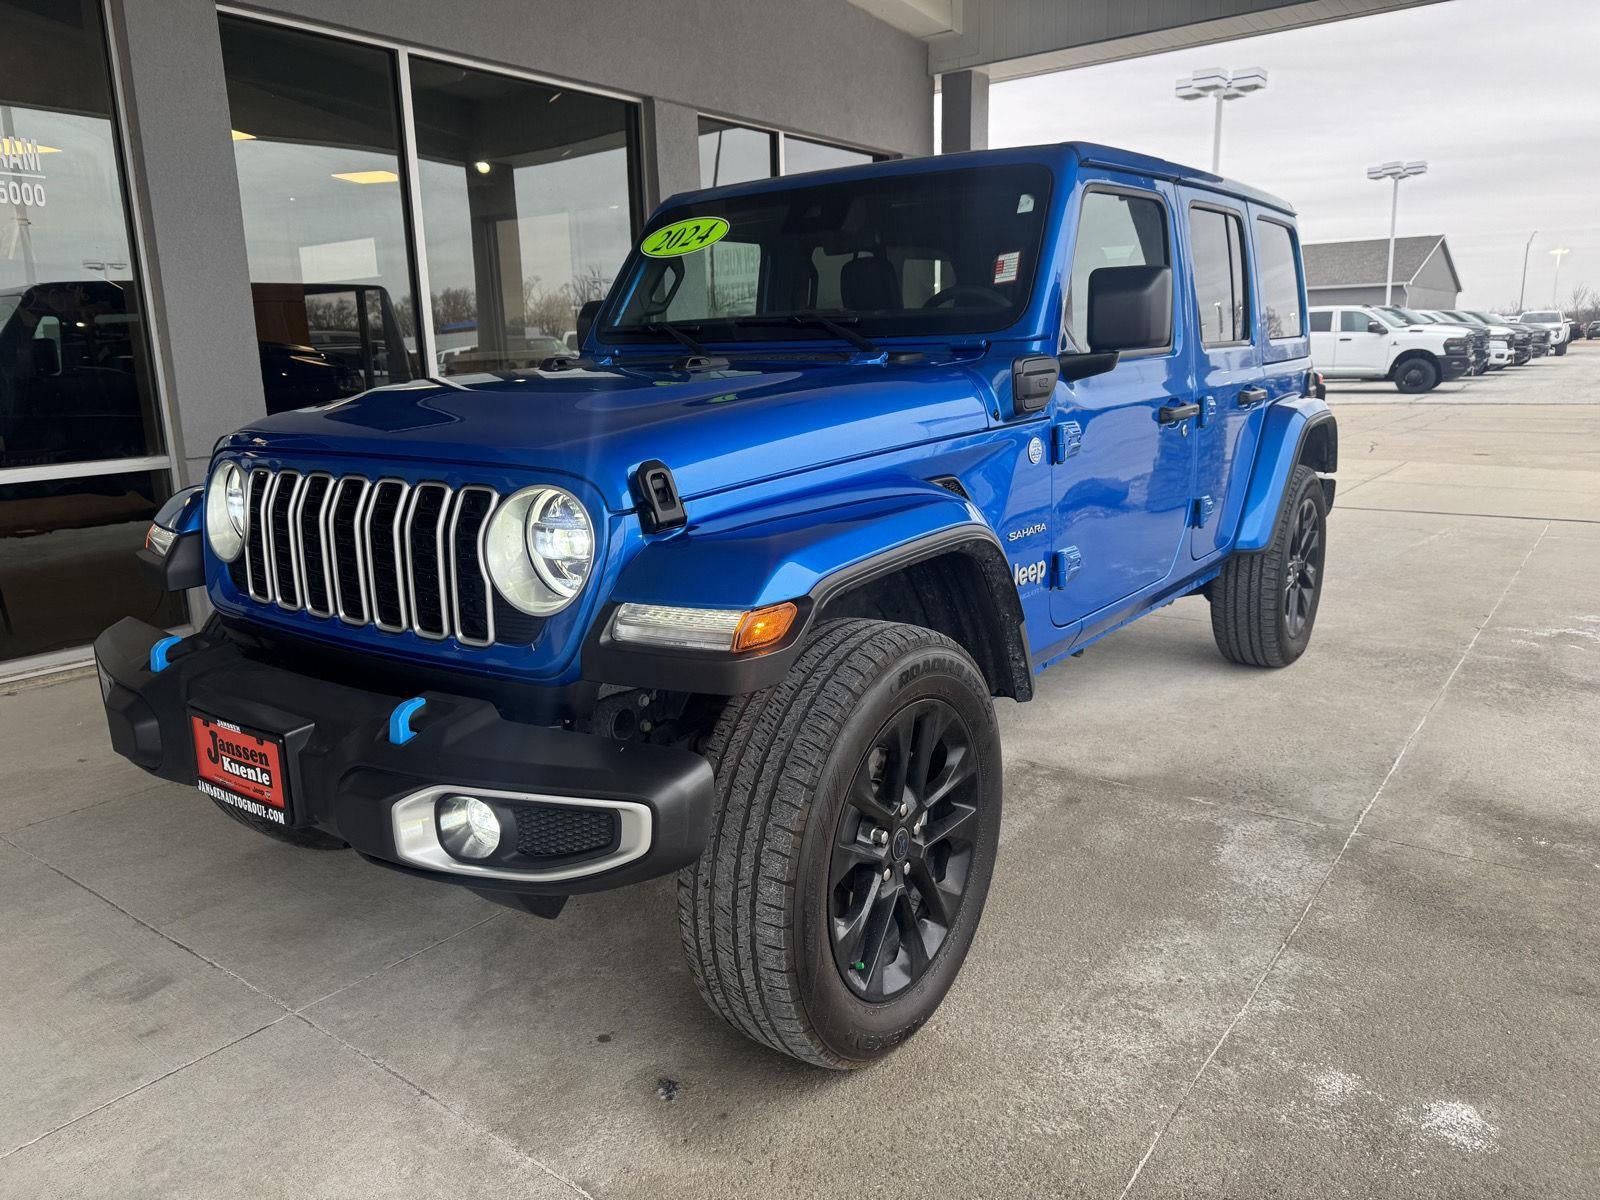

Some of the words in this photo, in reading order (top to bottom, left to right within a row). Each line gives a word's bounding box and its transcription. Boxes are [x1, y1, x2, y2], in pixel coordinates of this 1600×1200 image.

[650, 221, 719, 252] 2024
[1008, 523, 1047, 542] SAHARA
[1013, 560, 1047, 586] Jeep
[207, 730, 270, 767] Janssen
[221, 756, 271, 785] Kuenle
